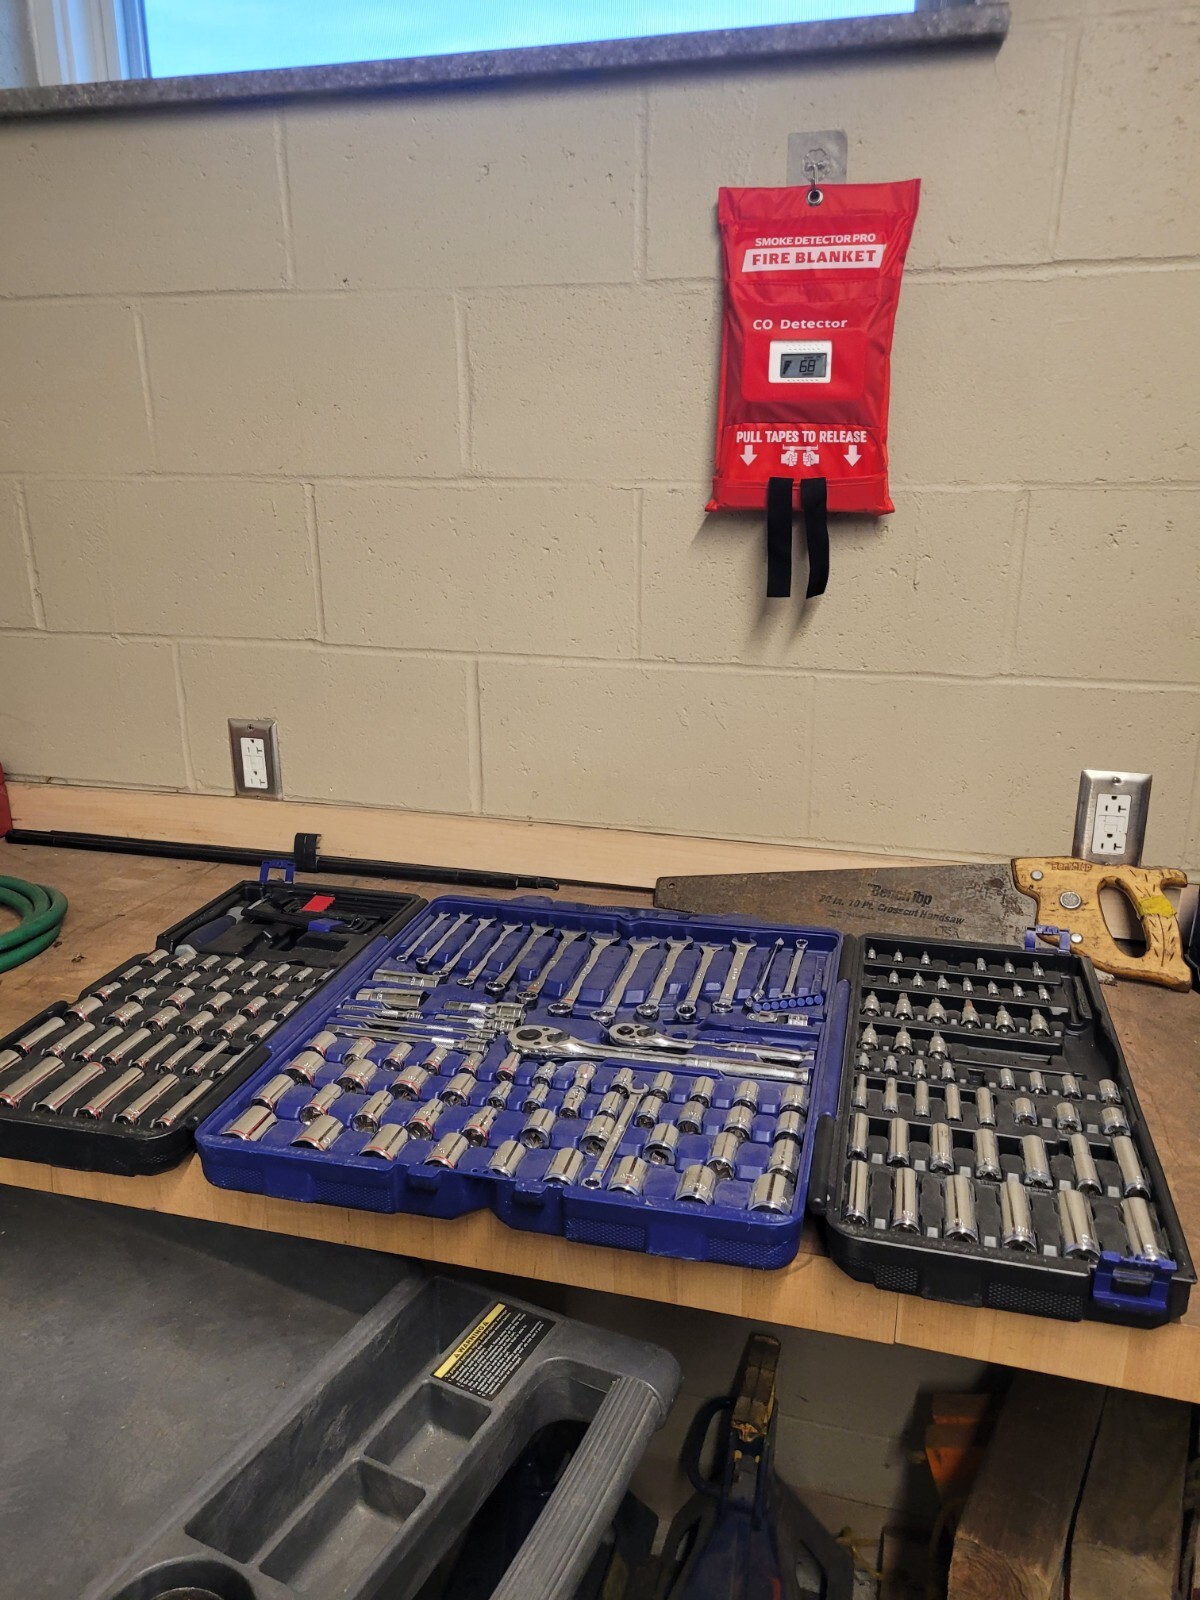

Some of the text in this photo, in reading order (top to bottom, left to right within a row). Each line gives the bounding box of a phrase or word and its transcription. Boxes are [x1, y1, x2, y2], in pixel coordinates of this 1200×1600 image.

[755, 234, 876, 246] SMOKE DETECTOR PRO
[752, 250, 876, 265] FIRE BLANKET
[753, 319, 847, 330] CO Detector
[736, 431, 867, 443] PULL TAPES TO RELEASE
[878, 903, 919, 916] Crosscut
[919, 911, 965, 924] Handsaw
[458, 1324, 486, 1353] WARNING
